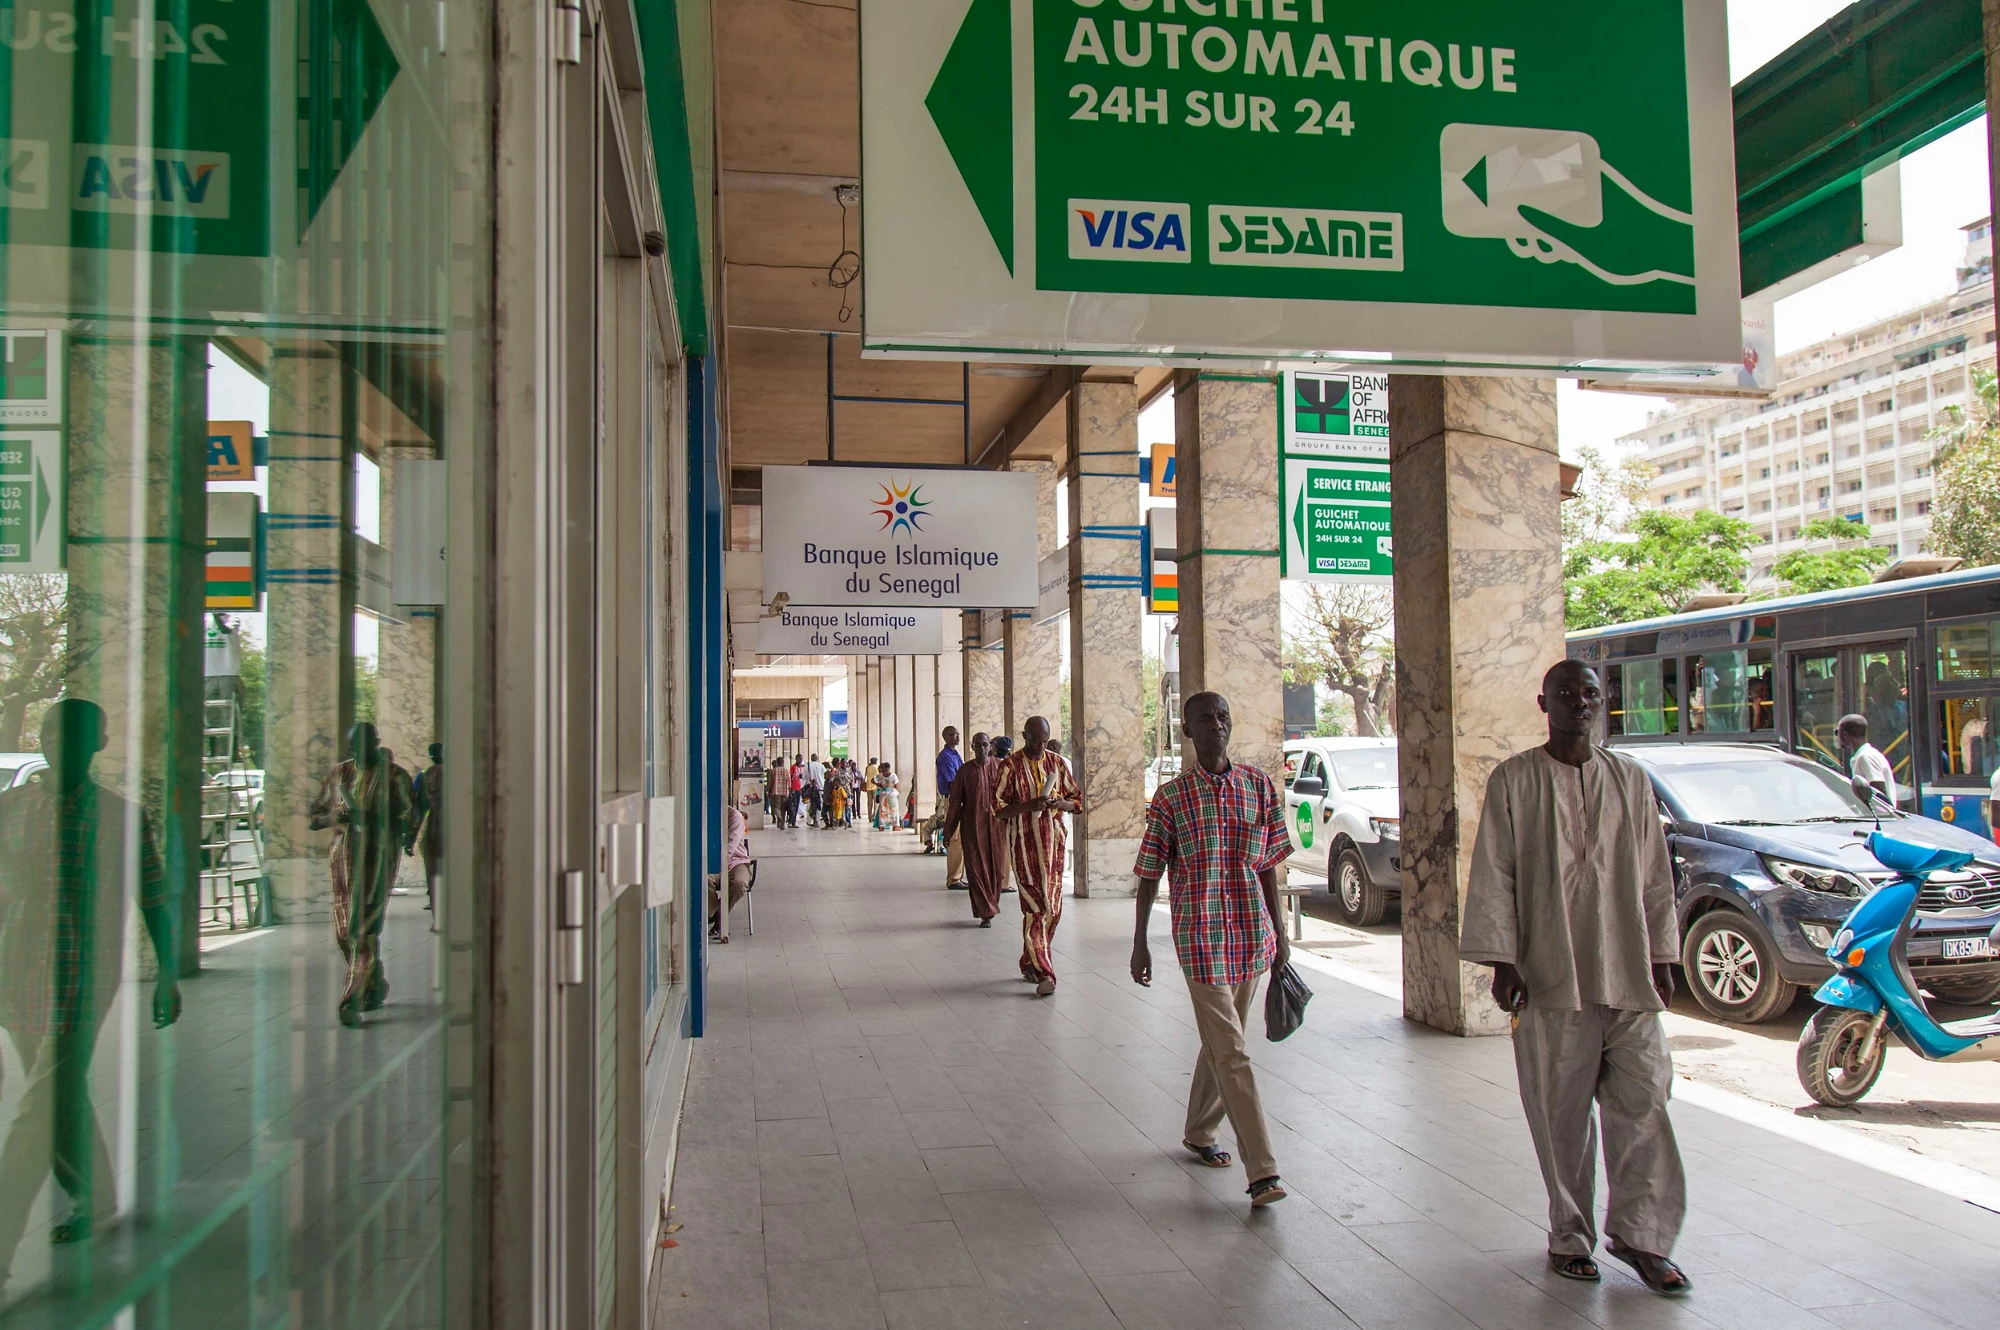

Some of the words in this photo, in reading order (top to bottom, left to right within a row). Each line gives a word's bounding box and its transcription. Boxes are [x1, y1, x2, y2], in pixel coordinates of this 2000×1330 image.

[1064, 17, 1517, 93] AUTOMATIQUE
[1068, 83, 1169, 125] 24H
[1184, 90, 1280, 133] SUR
[1294, 98, 1355, 137] 24
[1074, 209, 1186, 252] VISA
[1218, 214, 1394, 259] SESAME
[1352, 391, 1373, 407] OF
[1353, 408, 1390, 424] AFRI
[1294, 441, 1330, 449] GROUPE
[1313, 477, 1352, 491] SERVICE
[1314, 508, 1359, 520] GUICHET
[1315, 519, 1390, 531] AUTOMATIQUE
[1315, 534, 1332, 542] 24H
[1334, 535, 1350, 543] SUR
[803, 542, 887, 569] Banque
[896, 543, 999, 571] Islamique
[1318, 559, 1335, 567] VISA
[1340, 560, 1369, 568] SESAME
[845, 571, 870, 593] du
[878, 572, 960, 598] Senegal
[781, 611, 839, 630] Banque
[844, 611, 916, 630] Islamique
[810, 631, 828, 646] du
[833, 631, 889, 650] Senegal
